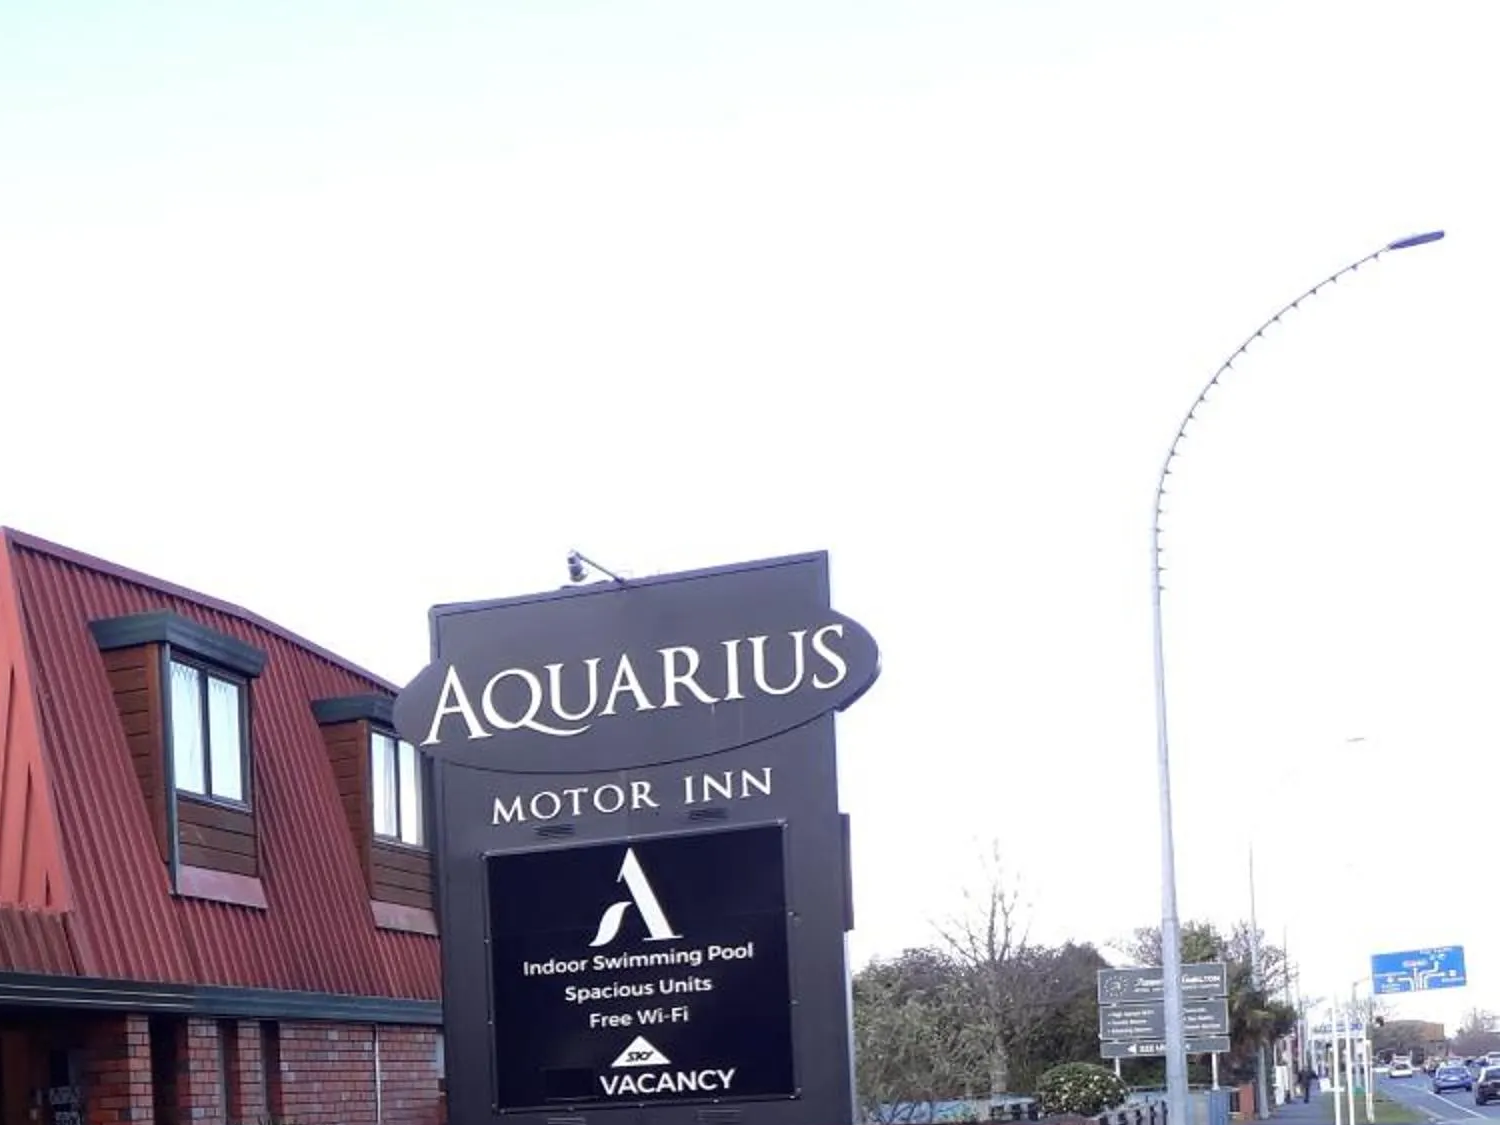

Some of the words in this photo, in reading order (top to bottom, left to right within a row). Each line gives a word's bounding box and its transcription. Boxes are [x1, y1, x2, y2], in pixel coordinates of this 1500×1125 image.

[419, 622, 848, 747] AQUARIUS
[491, 781, 659, 825] MOTOR
[685, 767, 773, 804] INN
[589, 847, 684, 947] A
[523, 957, 589, 977] Indoor
[592, 948, 703, 972] Swimming
[707, 941, 754, 961] Pool
[565, 983, 655, 1004] Spacious
[659, 975, 713, 995] Units
[589, 1012, 633, 1029] Free
[636, 1005, 690, 1025] Wi-Fi
[599, 1068, 736, 1096] VACANCY
